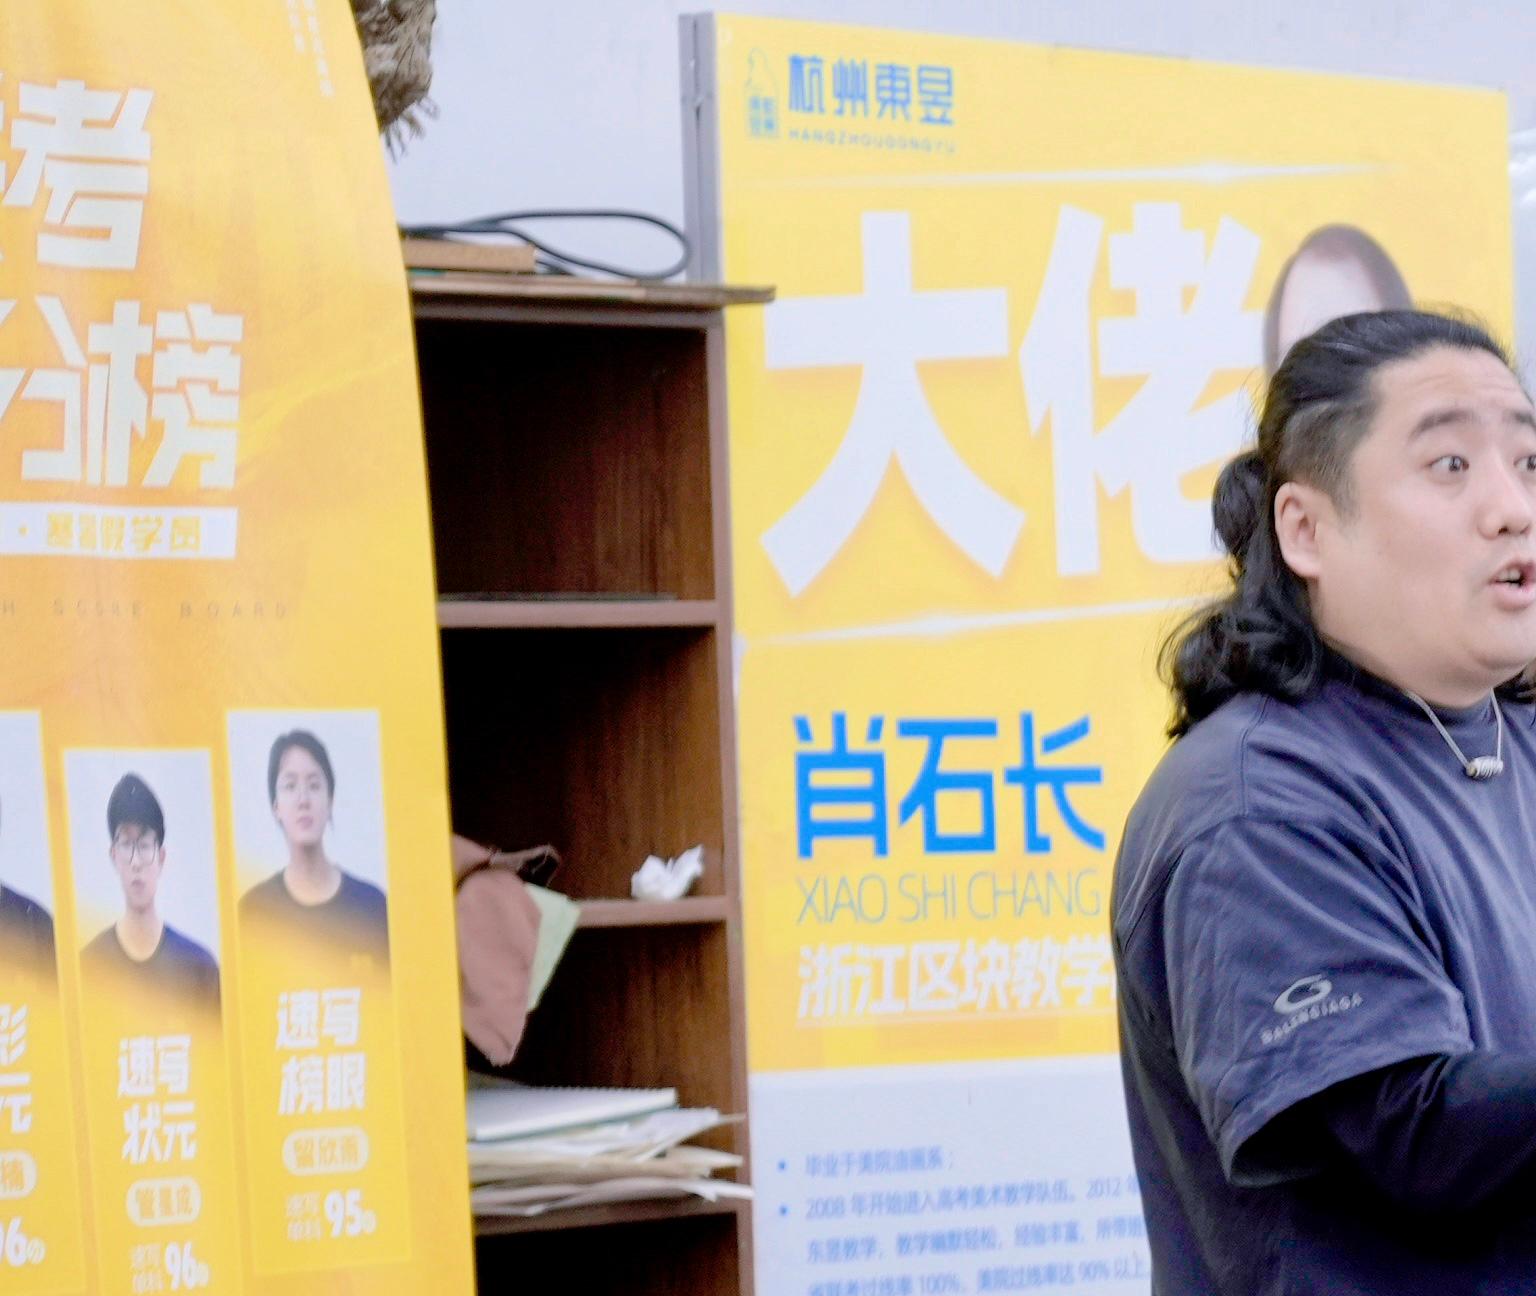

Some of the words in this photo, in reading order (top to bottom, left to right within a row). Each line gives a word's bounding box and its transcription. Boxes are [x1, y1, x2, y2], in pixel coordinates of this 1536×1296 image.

[759, 203, 1262, 598] 大佬
[792, 711, 1105, 859] 肖石长
[796, 874, 888, 927] XIAO
[899, 871, 958, 923] SHI
[967, 869, 1101, 922] CHANG
[797, 935, 1117, 1018] 浙江区块教学
[122, 1101, 197, 1165] 状元
